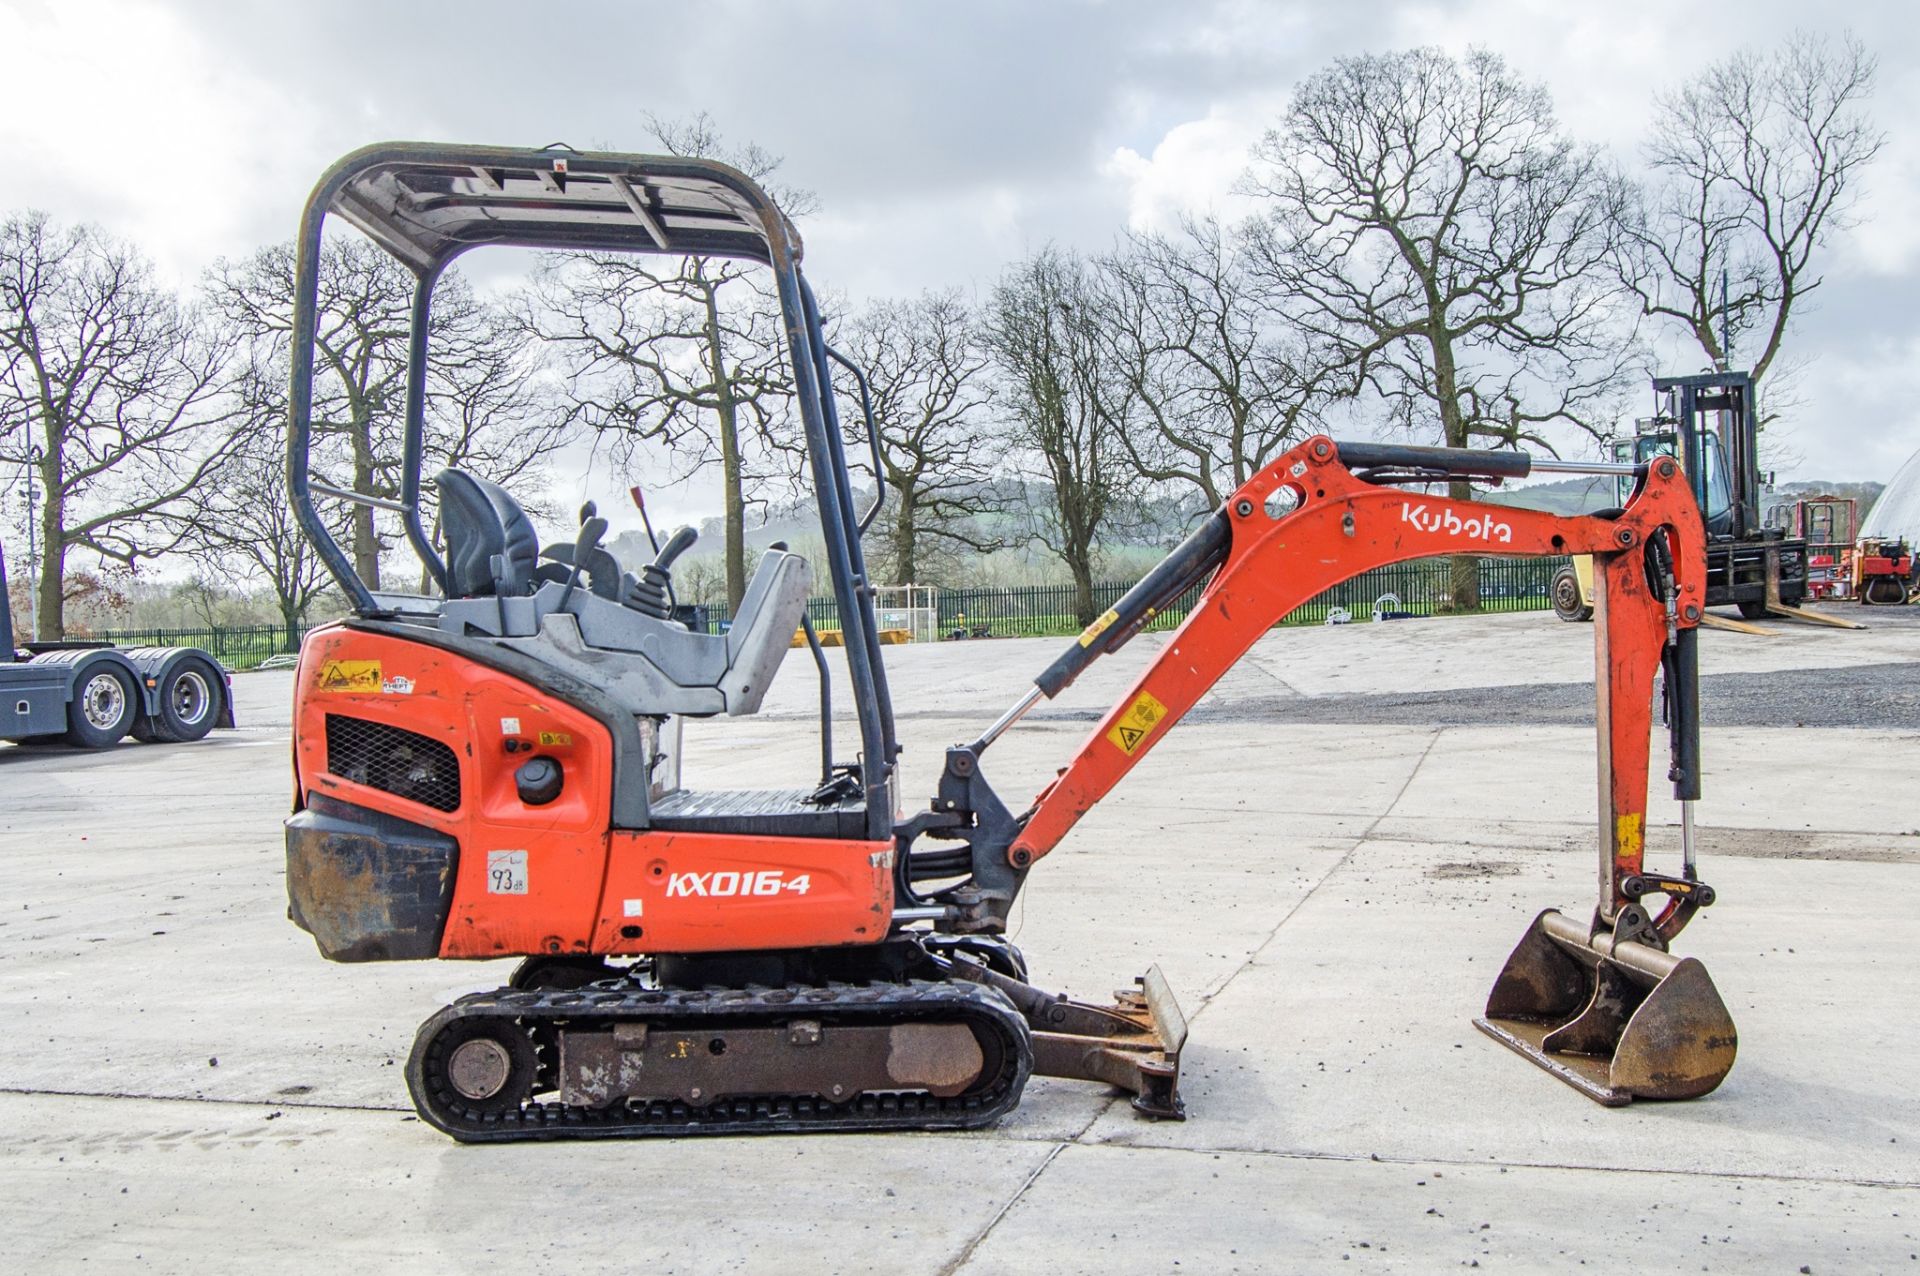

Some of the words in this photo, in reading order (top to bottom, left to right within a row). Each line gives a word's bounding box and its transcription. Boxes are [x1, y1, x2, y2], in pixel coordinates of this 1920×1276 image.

[1401, 502, 1512, 543] Kubota
[492, 869, 512, 890] 93
[665, 870, 811, 897] KX016-4
